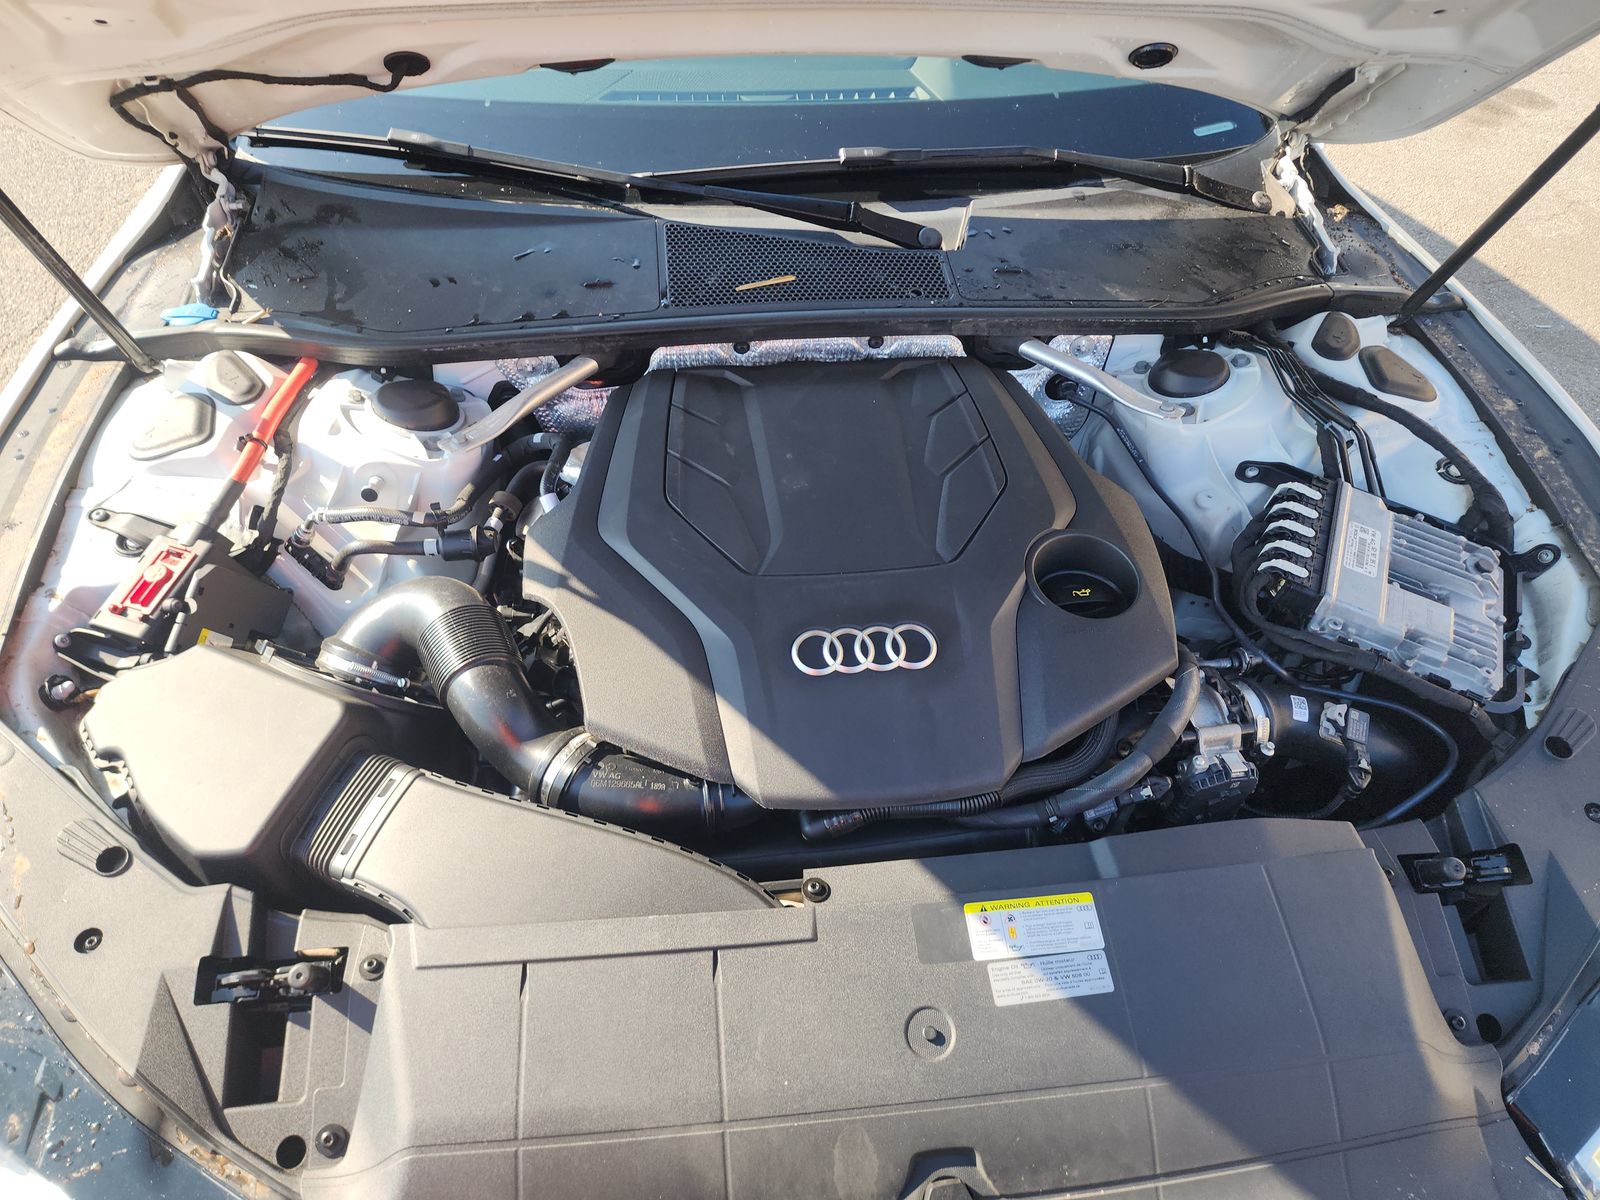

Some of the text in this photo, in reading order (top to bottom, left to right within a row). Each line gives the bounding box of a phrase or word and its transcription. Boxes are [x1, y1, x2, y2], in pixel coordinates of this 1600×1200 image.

[592, 770, 621, 780] VW AG
[989, 897, 1080, 911] WARNING ATTENTION
